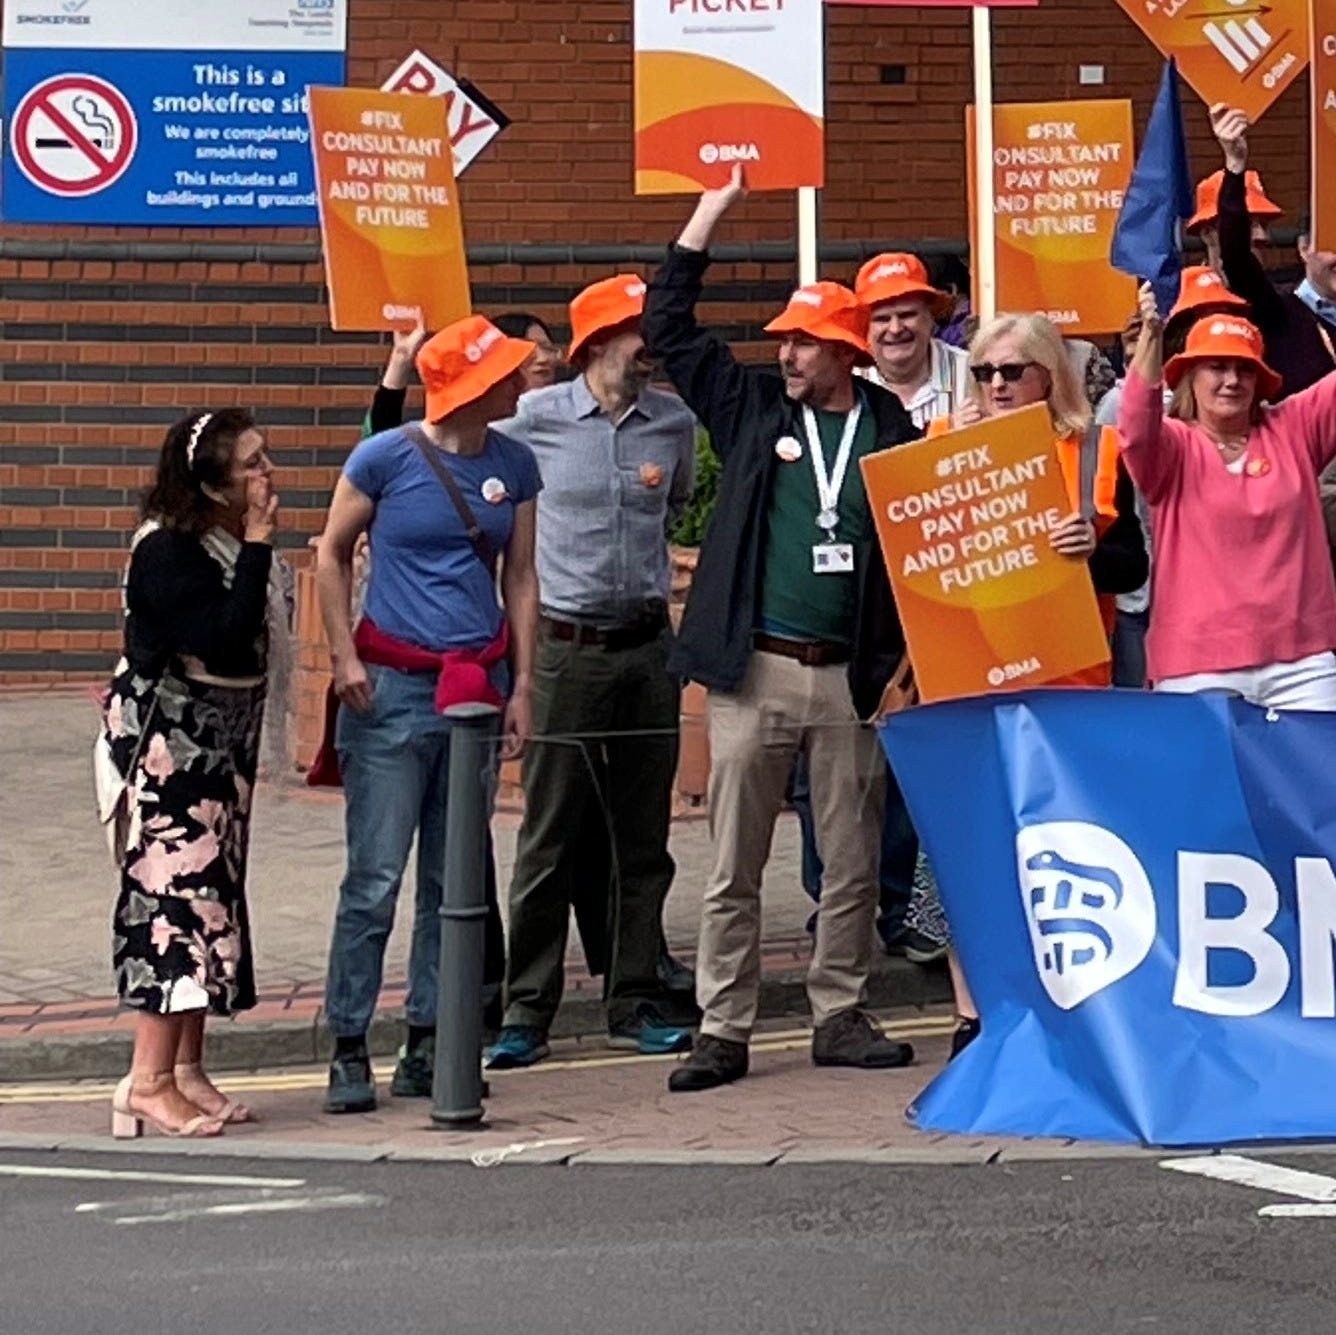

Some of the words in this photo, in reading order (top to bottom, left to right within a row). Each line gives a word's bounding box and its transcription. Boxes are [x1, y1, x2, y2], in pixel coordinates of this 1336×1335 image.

[193, 65, 240, 86] This
[247, 65, 263, 86] is
[272, 70, 285, 85] a
[153, 92, 274, 114] smokefree
[361, 111, 403, 131] #FIX
[1027, 122, 1077, 141] #FIX
[165, 125, 190, 140] We
[193, 128, 219, 140] are
[223, 125, 309, 143] completely
[322, 131, 442, 157] CONSULTANT
[196, 145, 278, 160] smokefree
[719, 144, 759, 161] BMA
[994, 142, 1122, 164] ONSULTANT
[175, 171, 207, 186] This
[210, 171, 274, 186] includes
[278, 171, 298, 186] all
[346, 158, 380, 176] PAY
[383, 159, 426, 178] NOW
[1005, 170, 1043, 189] PAY
[1048, 168, 1100, 187] NOW
[147, 191, 221, 208] buildings
[223, 191, 254, 206] and
[329, 183, 371, 201] AND
[374, 183, 412, 202] FOR
[413, 186, 449, 206] THE
[1033, 193, 1077, 212] FOR
[1080, 190, 1123, 210] THE
[356, 209, 429, 229] FUTURE
[1010, 214, 1097, 237] FUTURE
[934, 445, 993, 478] #FIX
[887, 455, 1048, 524] CONSULTANT
[921, 510, 965, 540] PAY
[970, 493, 1030, 527] NOW
[903, 542, 956, 577] AND
[959, 526, 1011, 560] FOR
[1014, 508, 1060, 545] THE
[939, 544, 1040, 594] FUTURE
[1004, 656, 1041, 681] BMA
